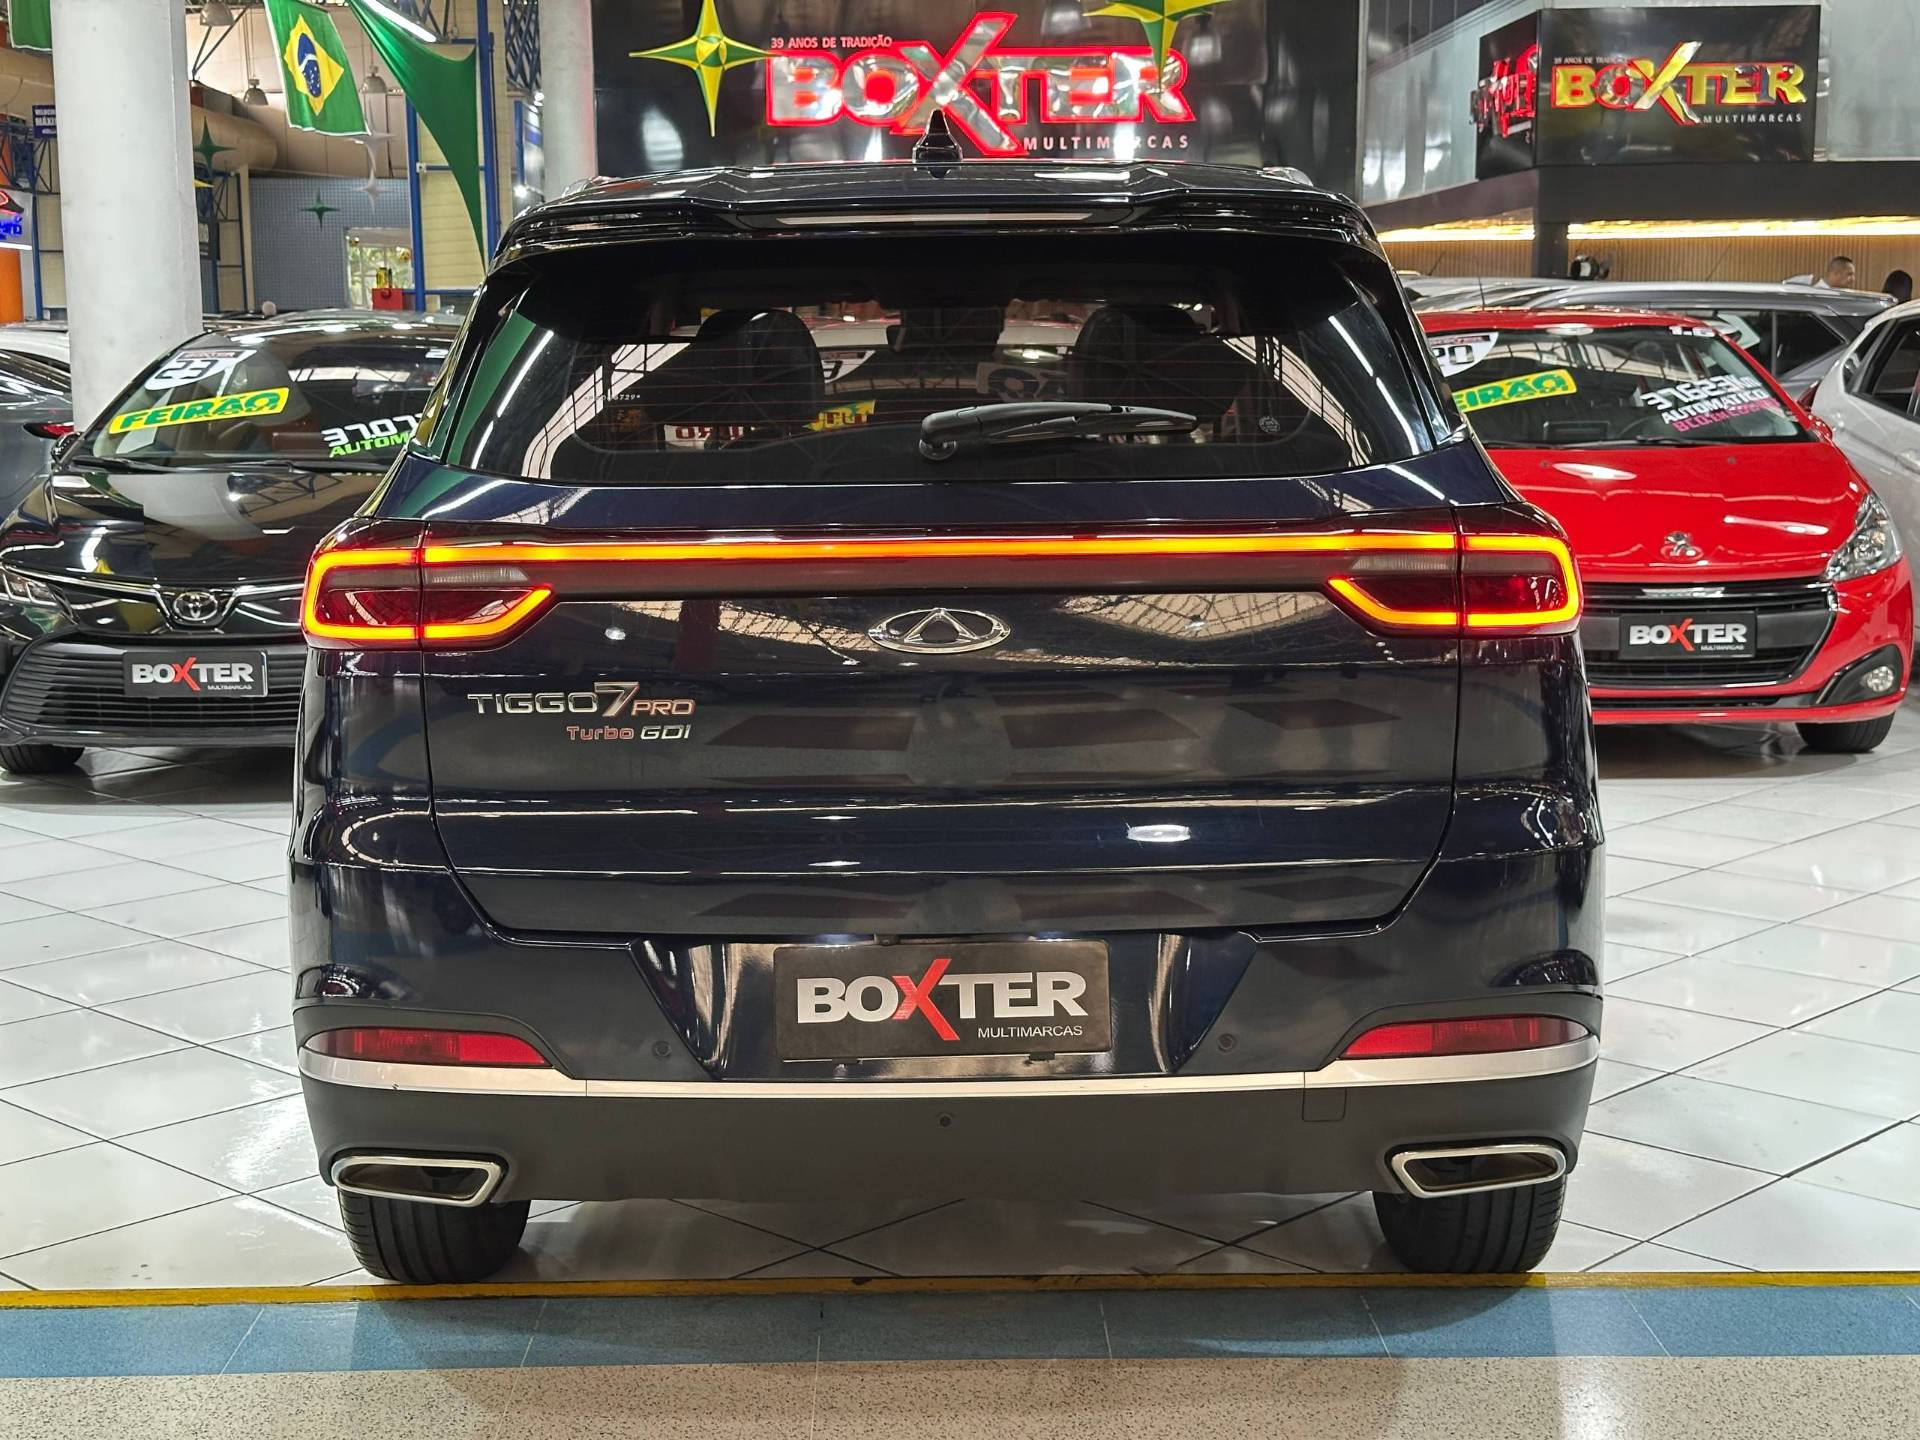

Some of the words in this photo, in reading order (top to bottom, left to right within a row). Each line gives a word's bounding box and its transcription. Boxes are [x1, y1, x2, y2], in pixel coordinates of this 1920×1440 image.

[771, 37, 784, 48] 39
[788, 37, 818, 48] ANOS
[822, 37, 836, 48] DE
[840, 34, 892, 48] TRADIÇÃO
[766, 11, 1196, 155] BOXTER
[1551, 41, 1807, 125] BOXTER
[1704, 113, 1802, 123] MULTIMARCAS
[1024, 135, 1189, 150] MULTIMRCAS
[119, 392, 281, 430] FEIRÃO
[1629, 617, 1747, 651] BOXTER
[132, 657, 254, 691] BOXTER
[566, 725, 635, 741] Turbo
[640, 724, 691, 740] GDI
[797, 958, 1089, 1041] BOXTER
[977, 1025, 1084, 1039] MULTIMARCAS
